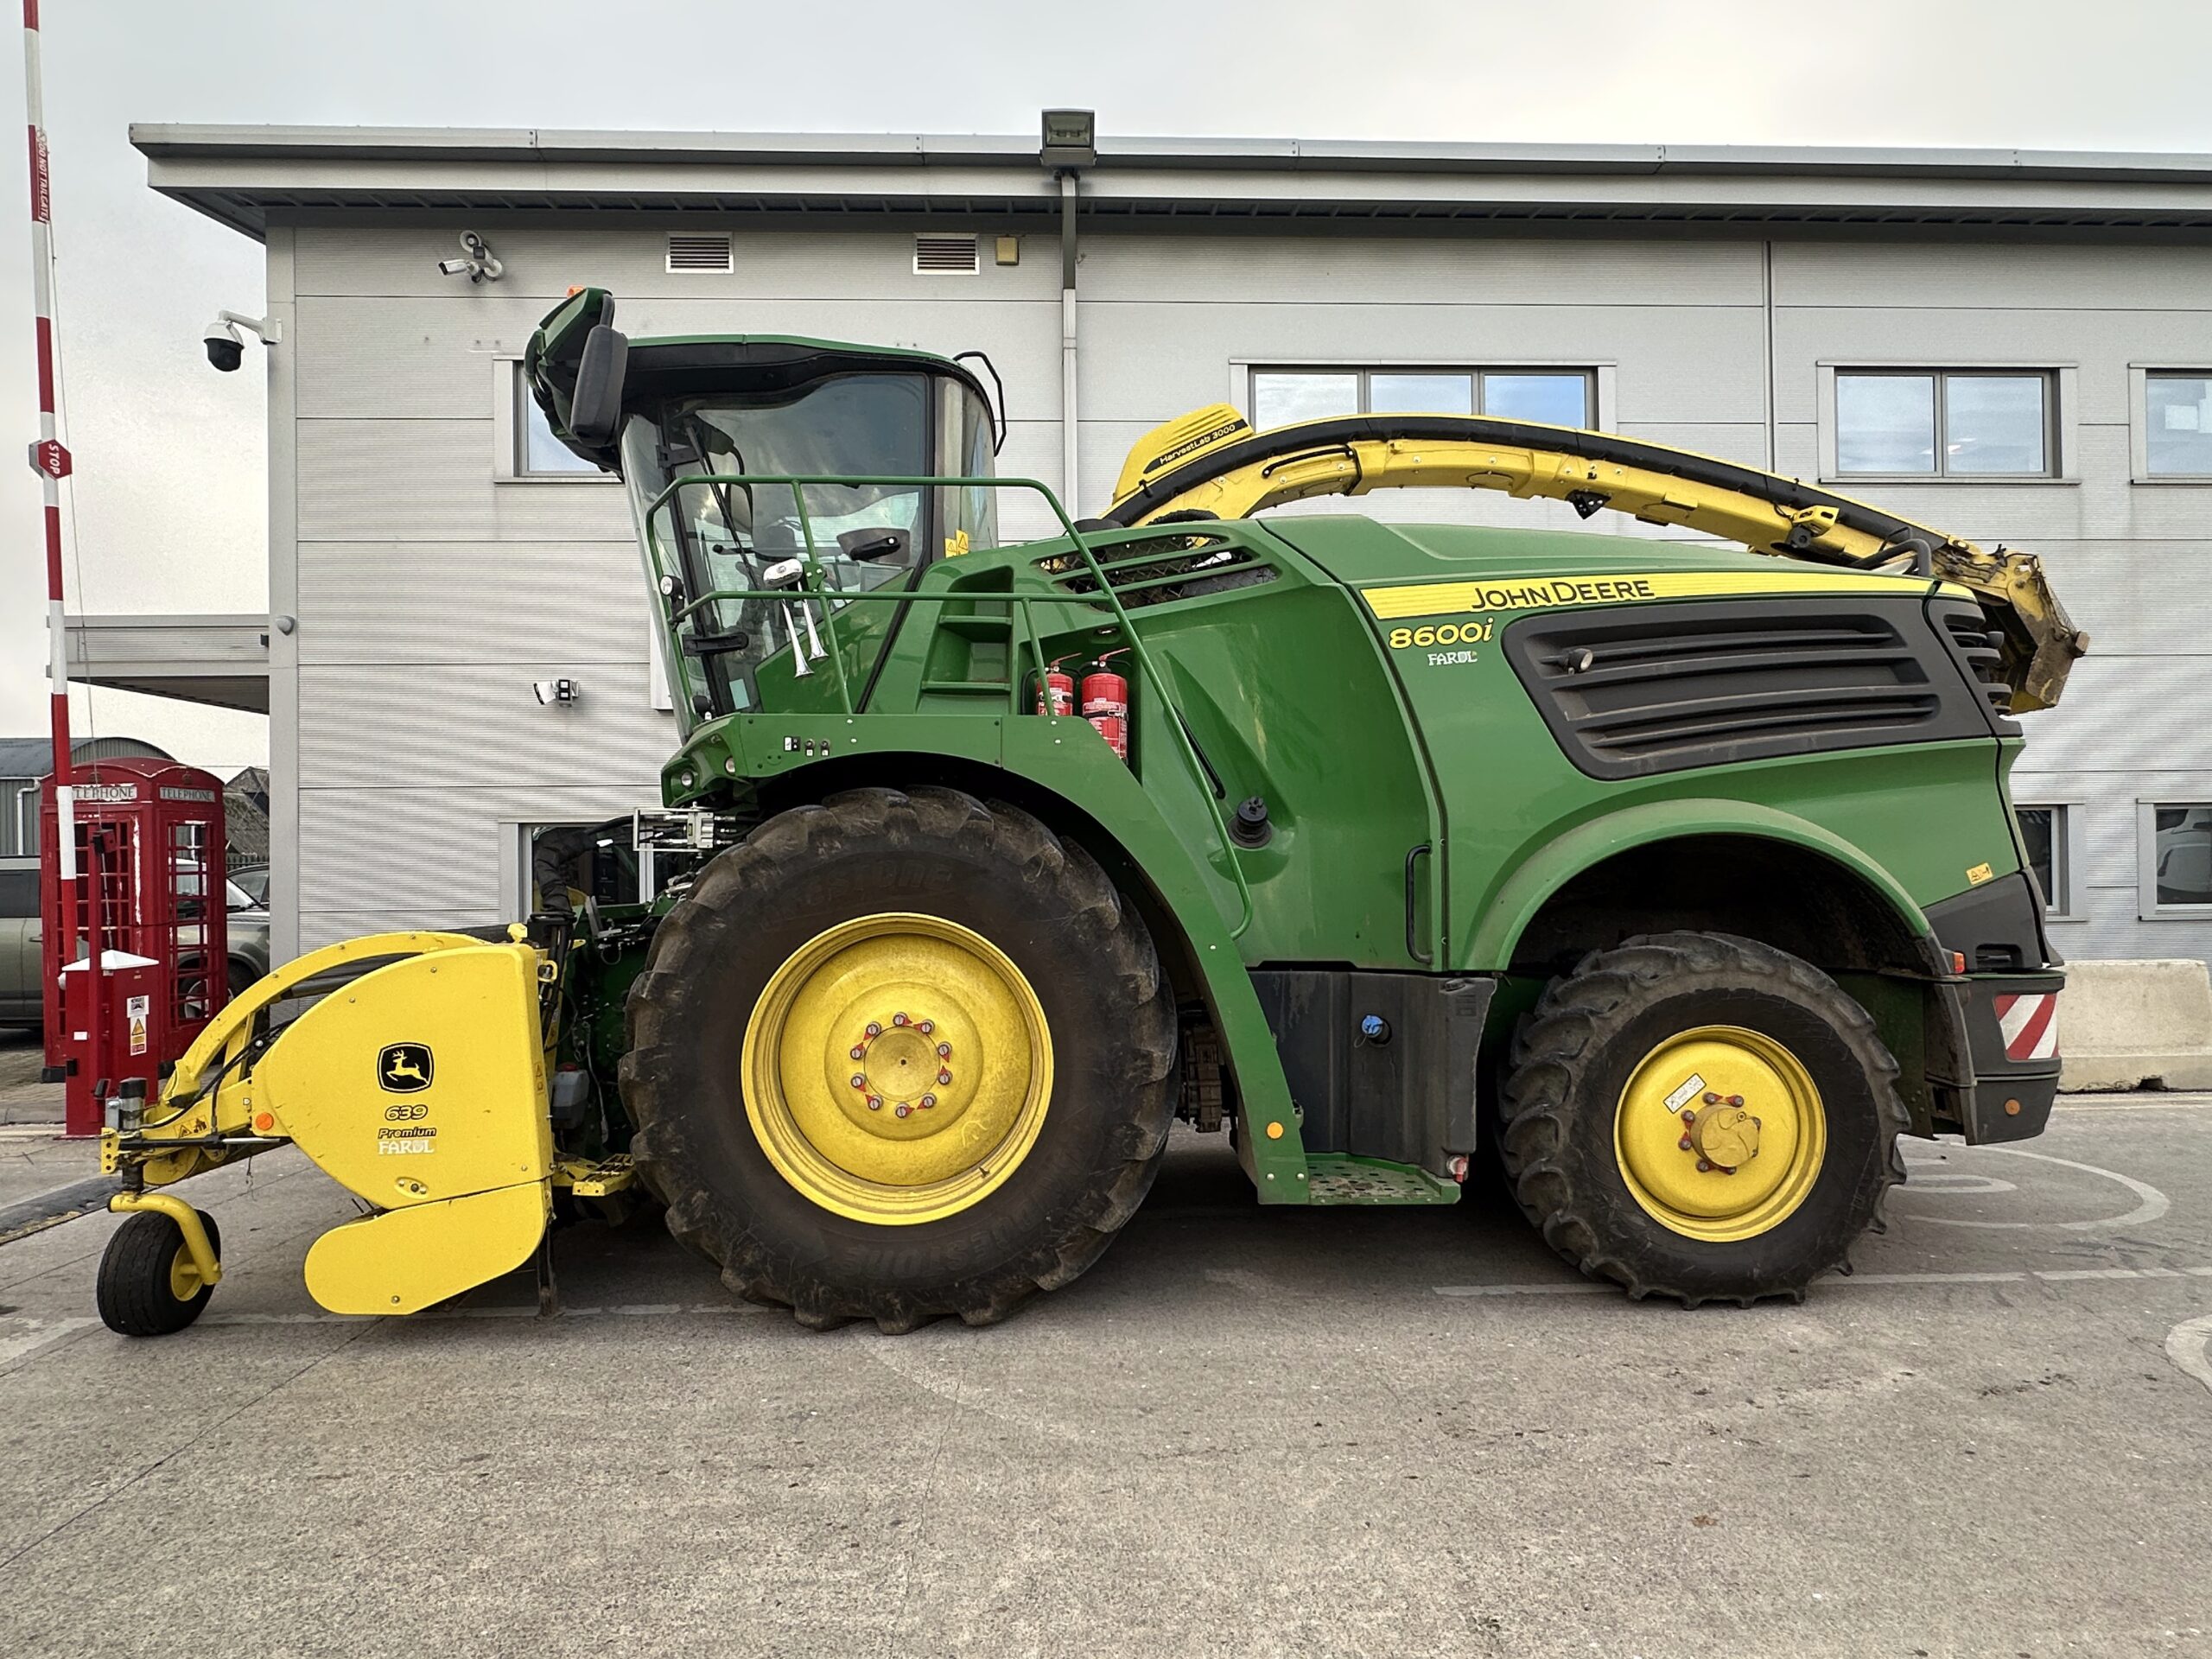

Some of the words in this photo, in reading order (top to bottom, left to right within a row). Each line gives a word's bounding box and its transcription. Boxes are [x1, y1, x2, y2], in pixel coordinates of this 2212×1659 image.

[38, 143, 47, 156] DO
[40, 177, 48, 219] TAILGATE
[1160, 436, 1211, 465] HarvestLab
[1211, 424, 1236, 440] 3000
[48, 443, 60, 474] STOP
[1471, 587, 1552, 609] JOHN
[1550, 580, 1655, 602] DEERE
[1389, 616, 1494, 649] 8600i
[1427, 650, 1478, 666] FAROL
[73, 785, 134, 798] LEPHONE
[162, 787, 213, 800] TELEPHONE
[385, 1104, 429, 1121] 639
[378, 1127, 437, 1140] Premium
[378, 1140, 435, 1155] FAROL
